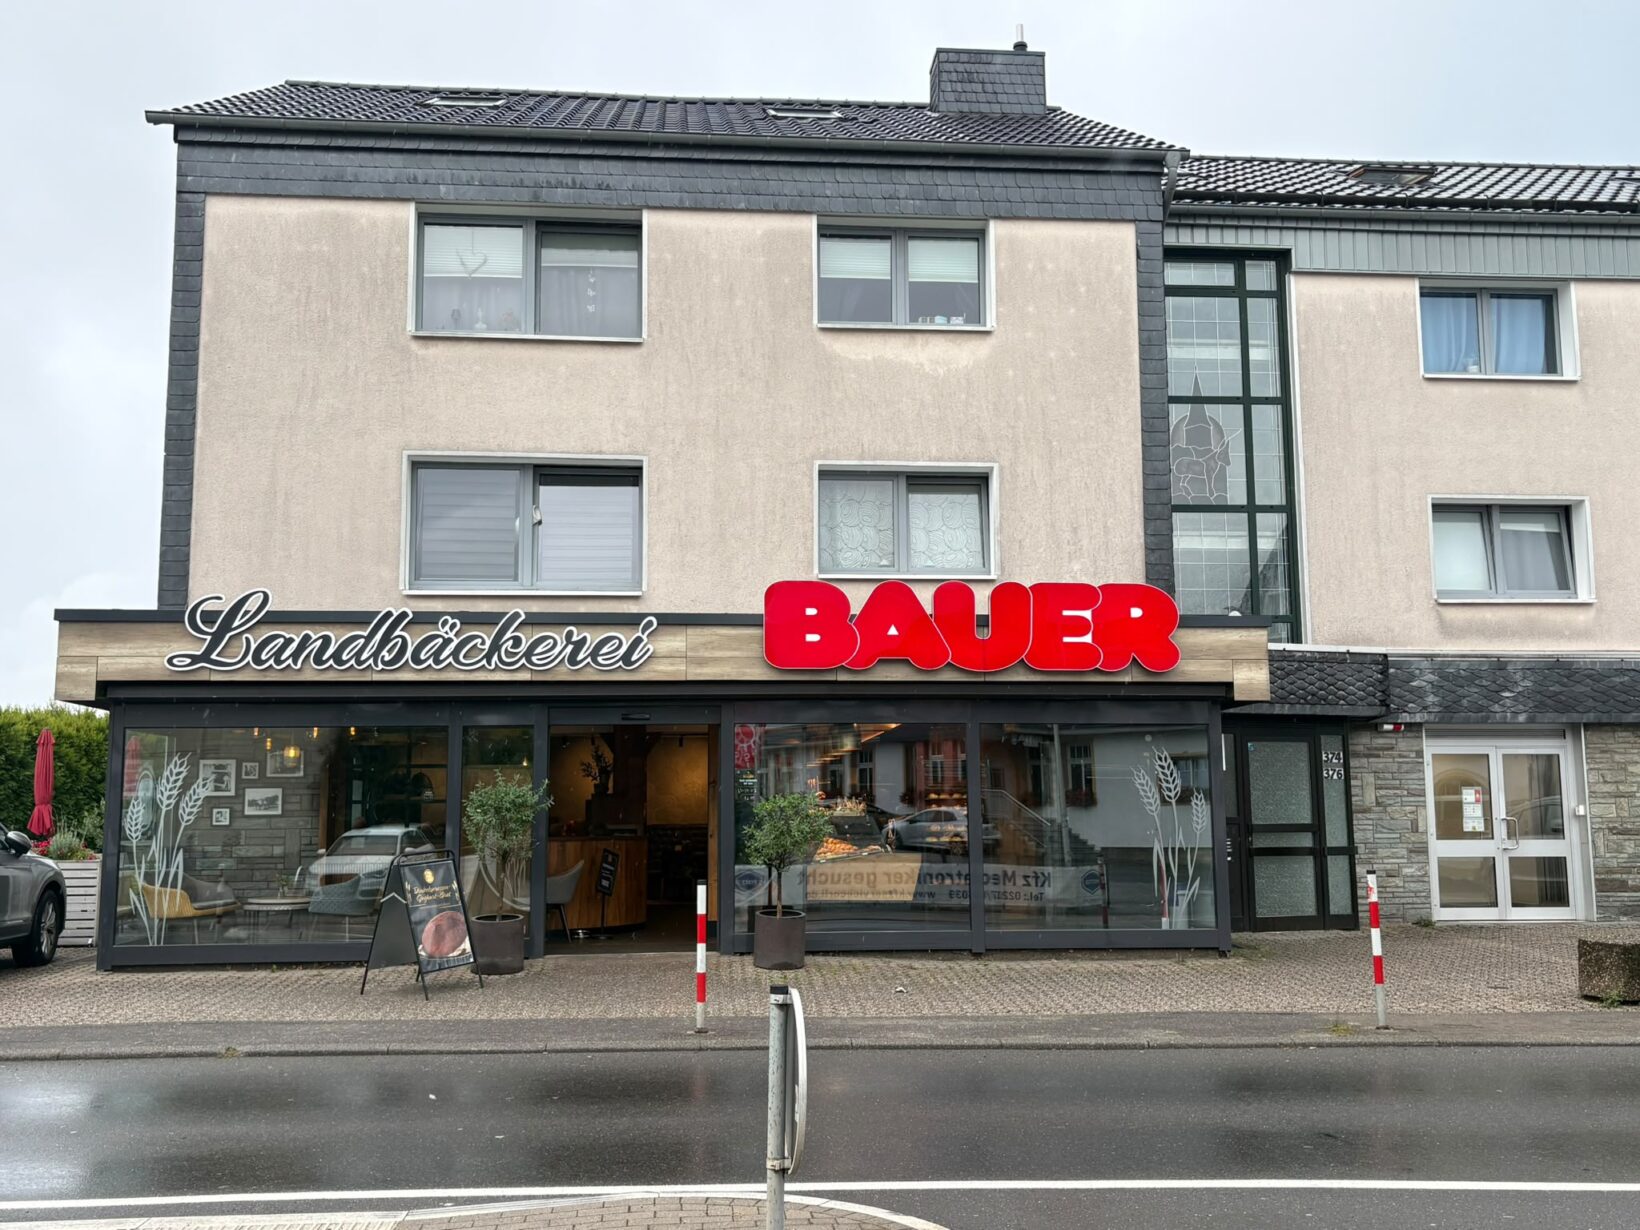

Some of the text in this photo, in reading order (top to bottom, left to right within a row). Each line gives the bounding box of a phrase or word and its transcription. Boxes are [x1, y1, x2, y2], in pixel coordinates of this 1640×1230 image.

[164, 580, 1181, 673] Landbäckerei BAUER
[1323, 751, 1342, 763] 374
[1323, 768, 1344, 780] 376
